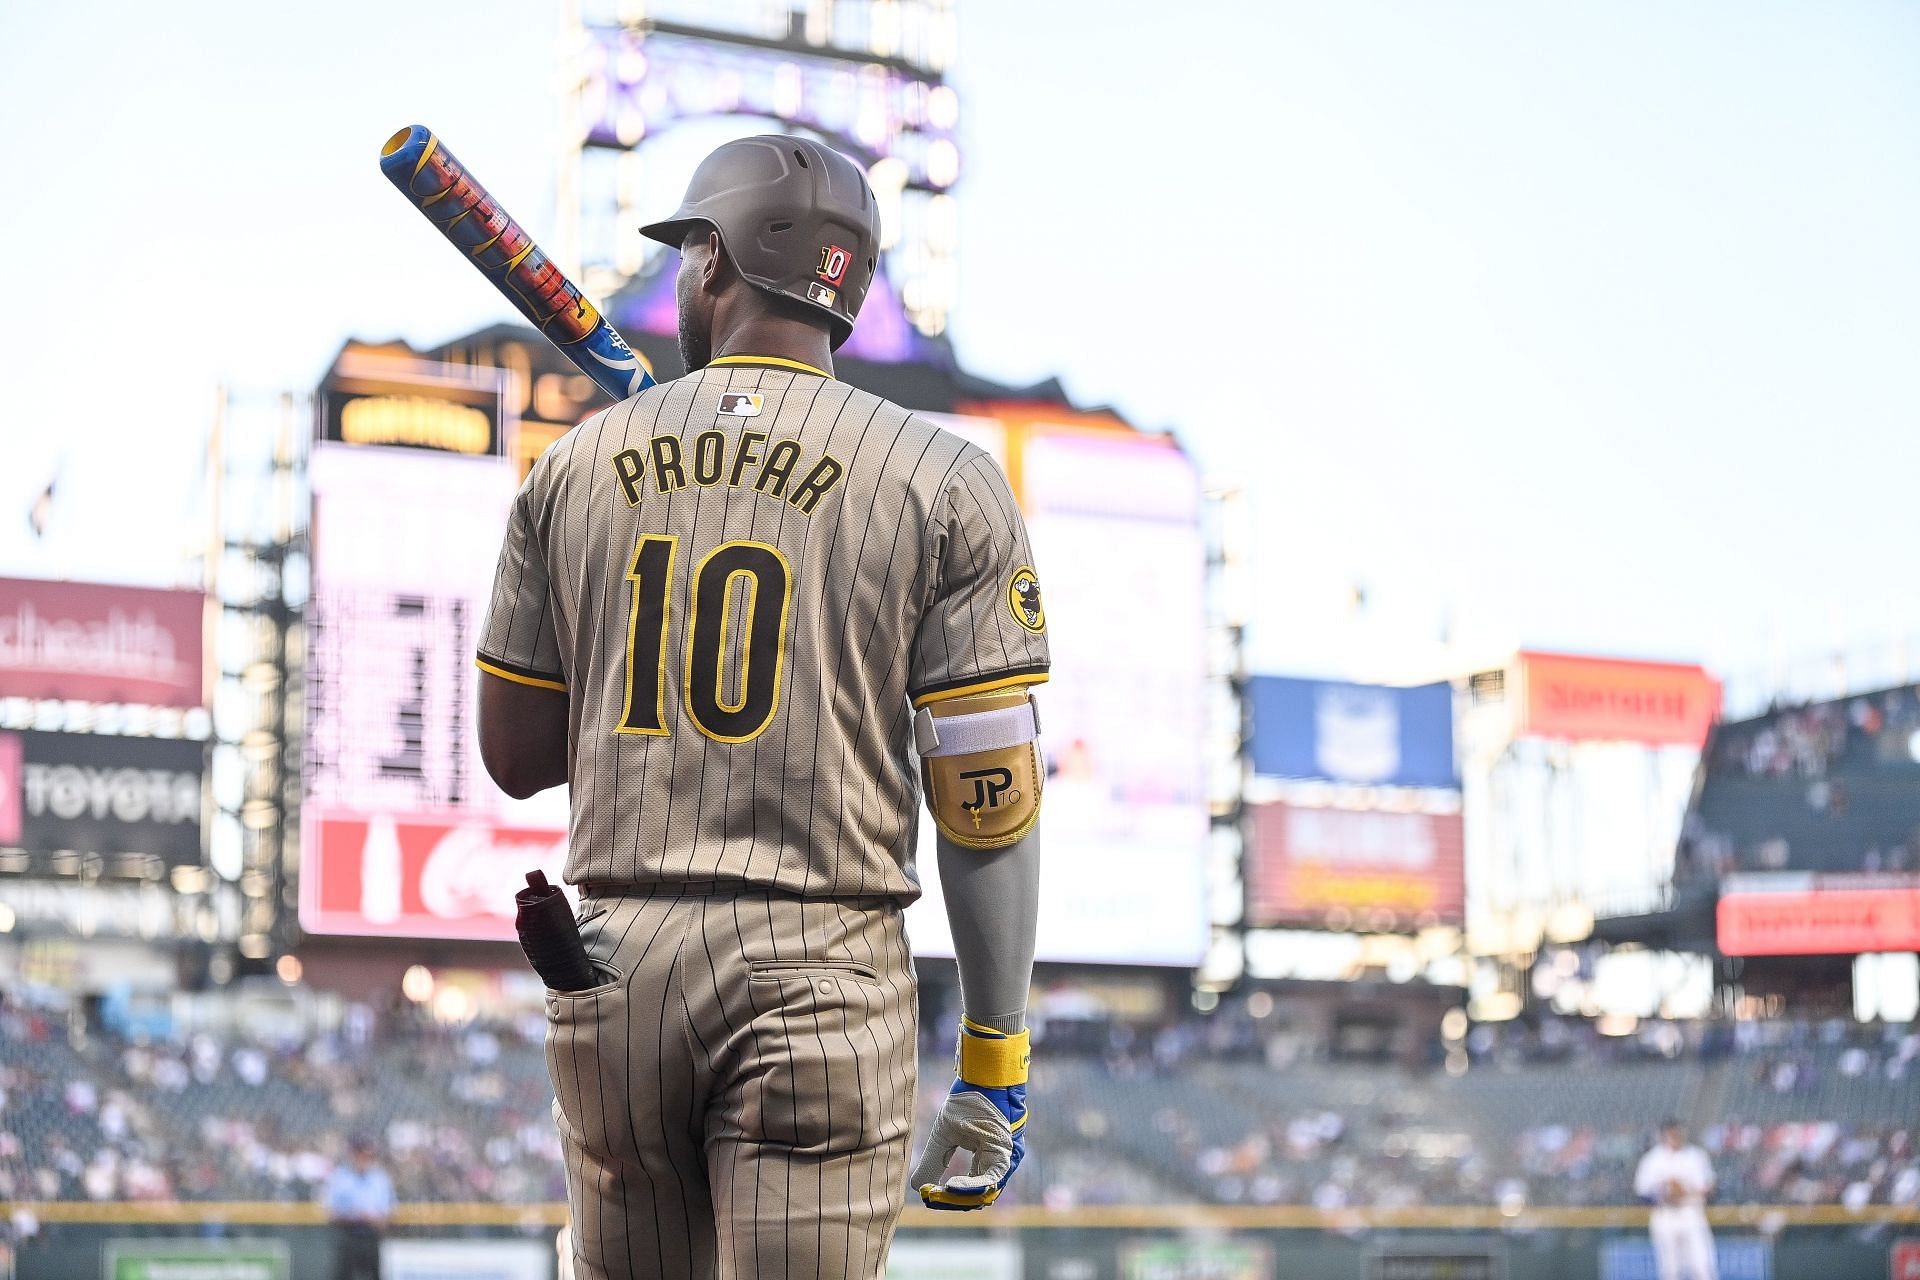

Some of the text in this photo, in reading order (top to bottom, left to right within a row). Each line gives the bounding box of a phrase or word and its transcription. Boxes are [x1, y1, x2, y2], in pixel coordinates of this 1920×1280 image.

[816, 246, 845, 280] 10
[611, 429, 844, 516] PROFAR
[614, 533, 793, 744] 10
[25, 763, 200, 826] TOYOTA
